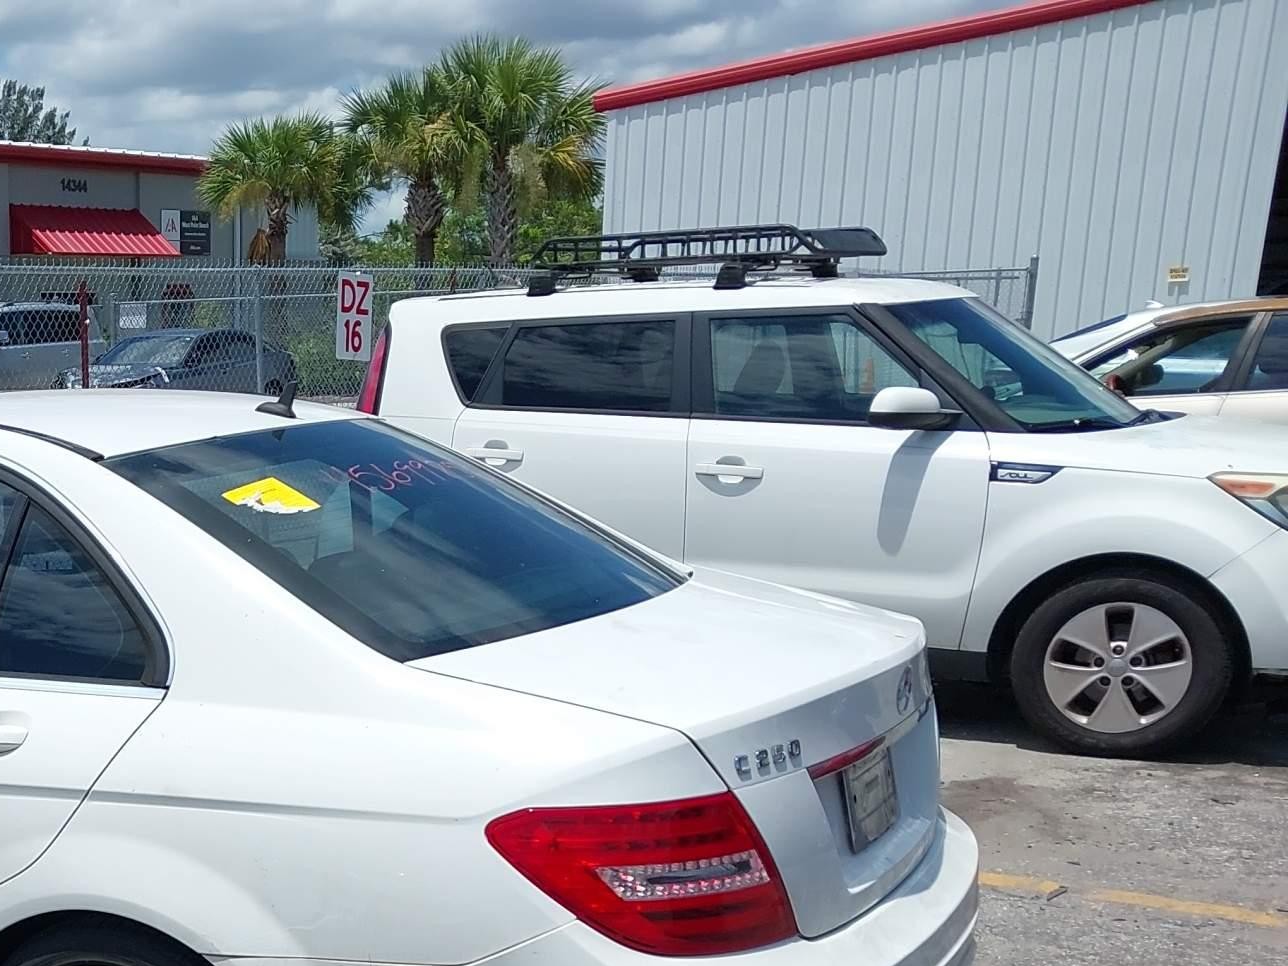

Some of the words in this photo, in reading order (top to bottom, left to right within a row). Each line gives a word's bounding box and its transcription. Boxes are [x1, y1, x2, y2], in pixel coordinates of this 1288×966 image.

[61, 178, 88, 192] 14344
[341, 279, 370, 315] DZ
[344, 319, 363, 352] 16
